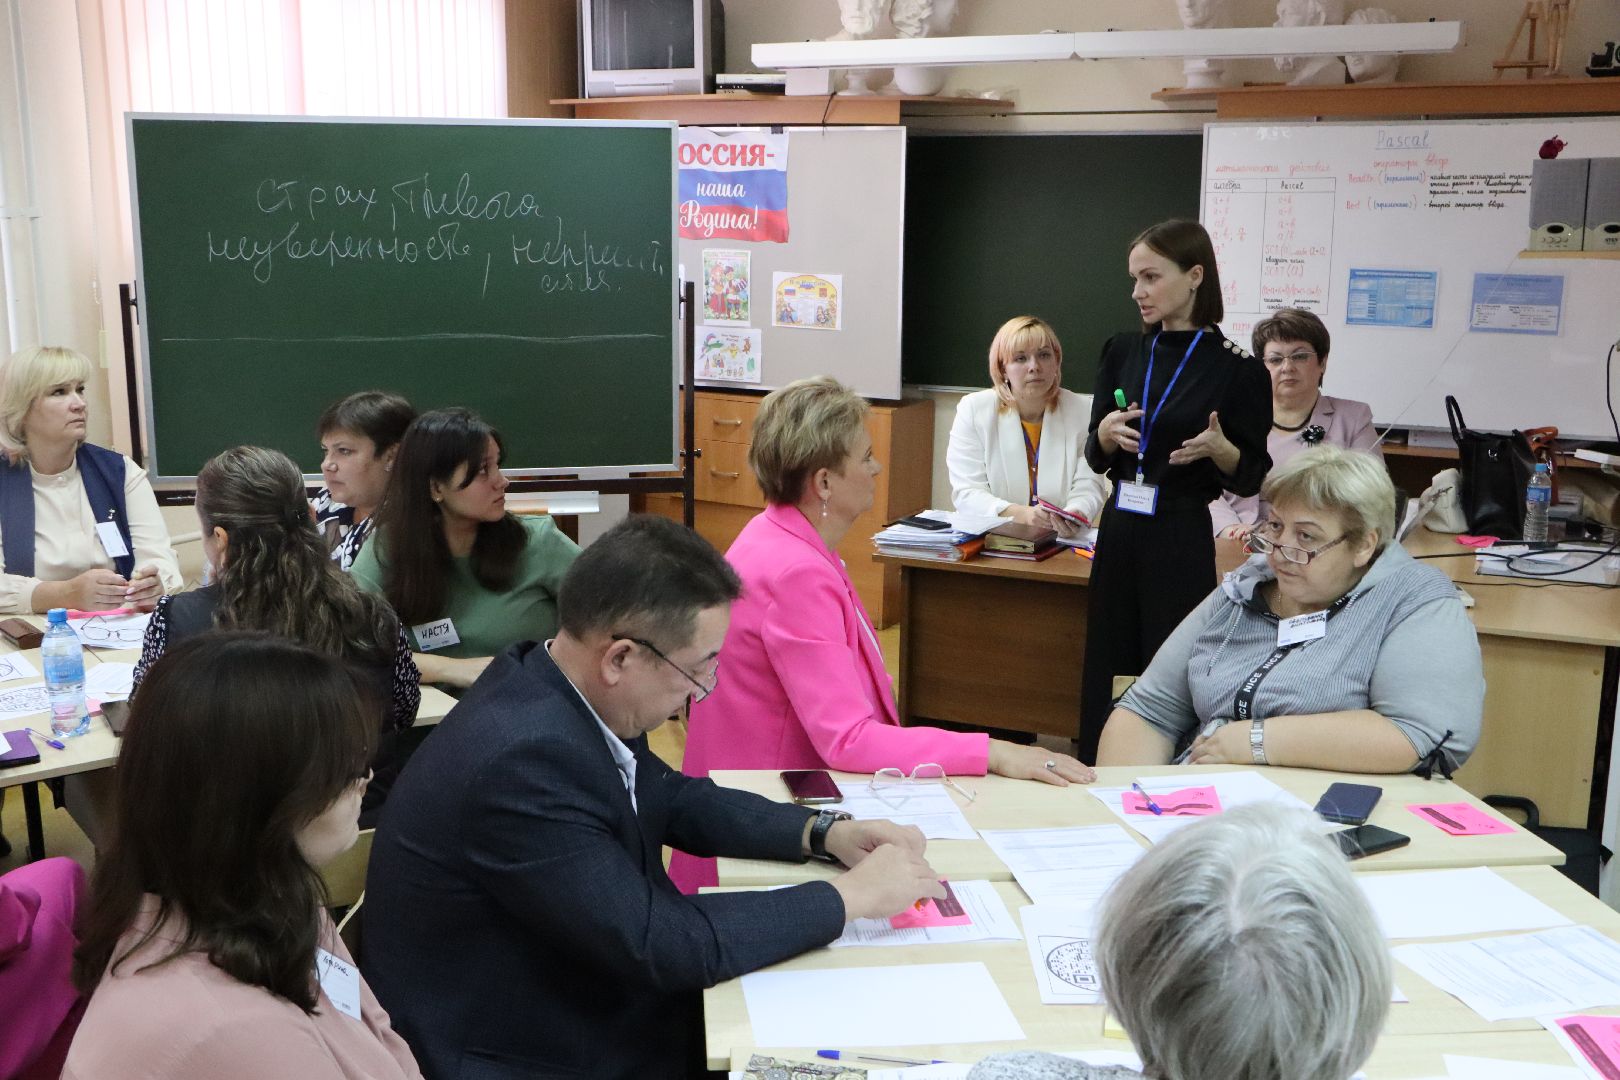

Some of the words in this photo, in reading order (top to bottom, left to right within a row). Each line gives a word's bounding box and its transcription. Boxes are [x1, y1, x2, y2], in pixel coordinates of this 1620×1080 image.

[678, 143, 775, 167] ОССИЯ-
[695, 182, 747, 198] наша
[678, 199, 760, 238] Родина!
[421, 622, 450, 640] НАСТЯ
[1263, 652, 1284, 670] NICE
[1243, 671, 1263, 693] NICE
